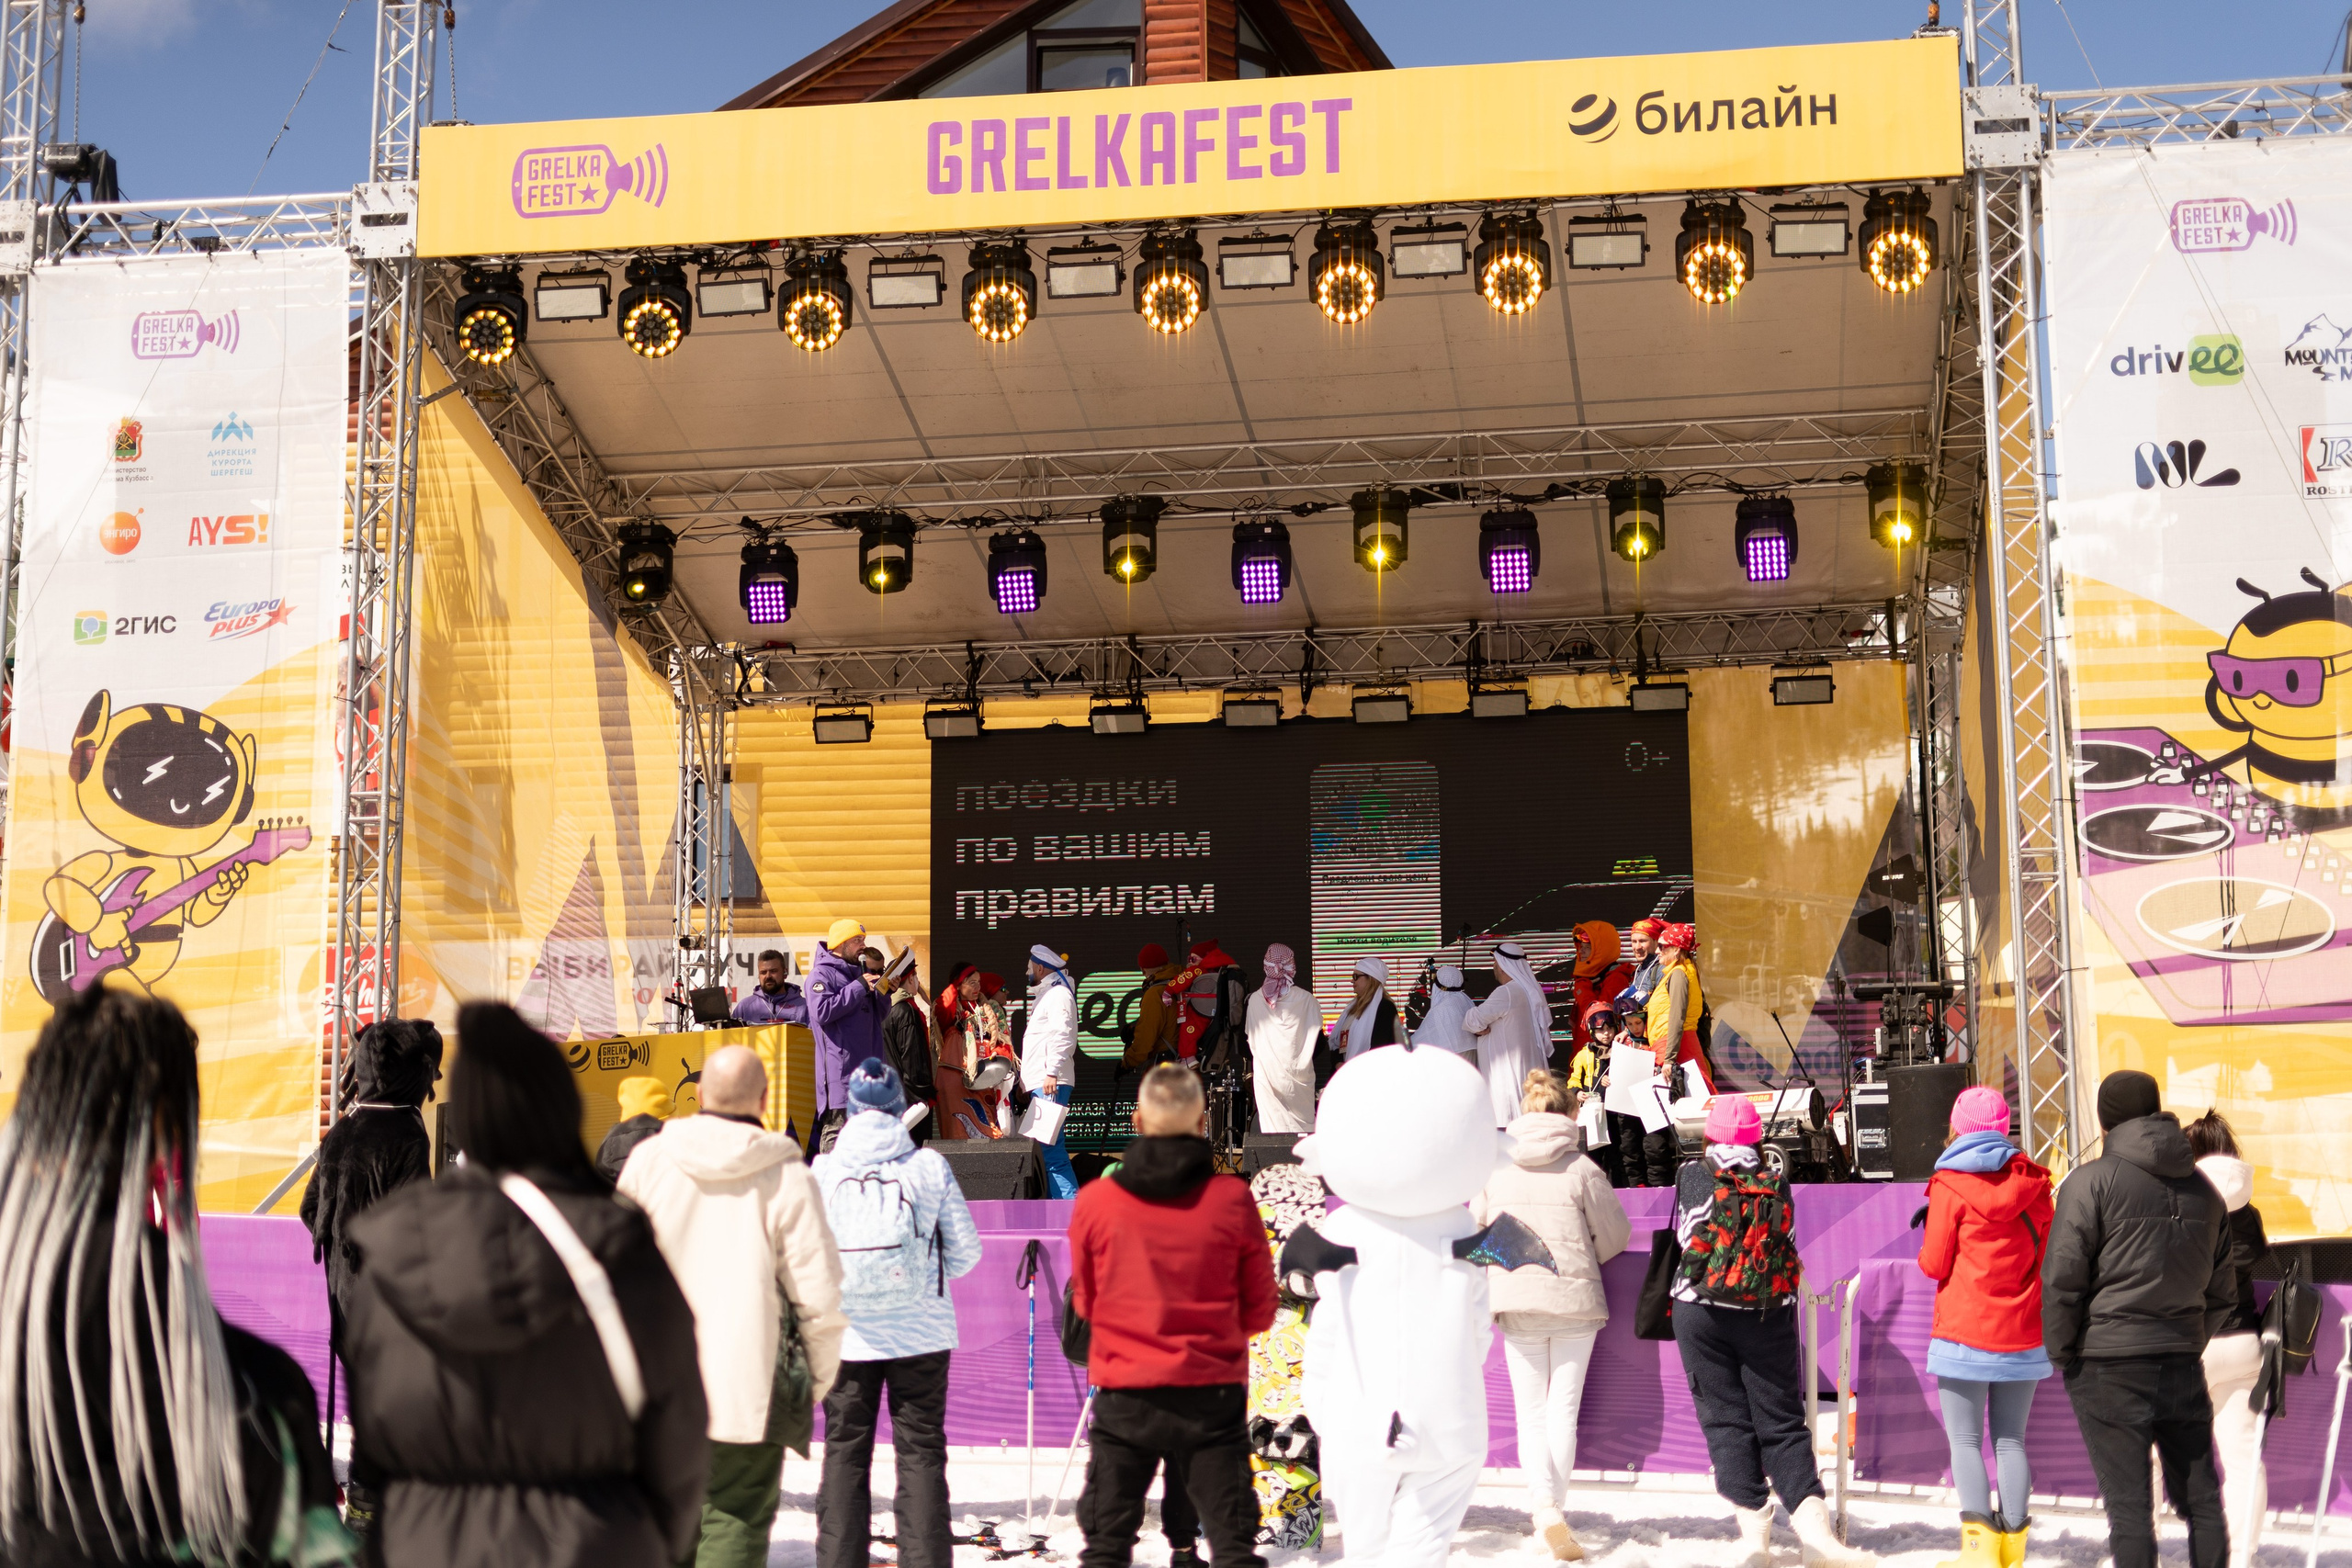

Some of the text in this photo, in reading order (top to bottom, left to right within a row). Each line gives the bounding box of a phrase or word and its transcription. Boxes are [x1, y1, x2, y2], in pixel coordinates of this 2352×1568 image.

[1635, 85, 1837, 135] билайн
[926, 97, 1353, 195] GRELKAFEST
[527, 154, 601, 181] GRELKA
[527, 183, 577, 208] FEST
[2182, 205, 2243, 225] GRELKA
[2183, 227, 2223, 245] FEST
[141, 316, 194, 334] GRELKA
[141, 336, 176, 353] FEST
[2110, 343, 2245, 378] drivee
[207, 448, 257, 458] ДИРЕКЦИЯ
[211, 458, 253, 467] КУРОРТА
[210, 468, 253, 477] ШЕРЕГЕШ
[2306, 485, 2352, 496] ROST
[103, 528, 138, 540] энгиро
[188, 514, 268, 547] AYS!
[115, 615, 176, 636] 2ГИС
[1625, 740, 1670, 772] 0+
[956, 778, 1177, 812] поездки
[956, 831, 1211, 863] по вашим
[956, 884, 1215, 930] правилам
[602, 1045, 628, 1056] GRELKA
[602, 1056, 620, 1066] FEST
[1064, 1122, 1091, 1136] ЕРТА
